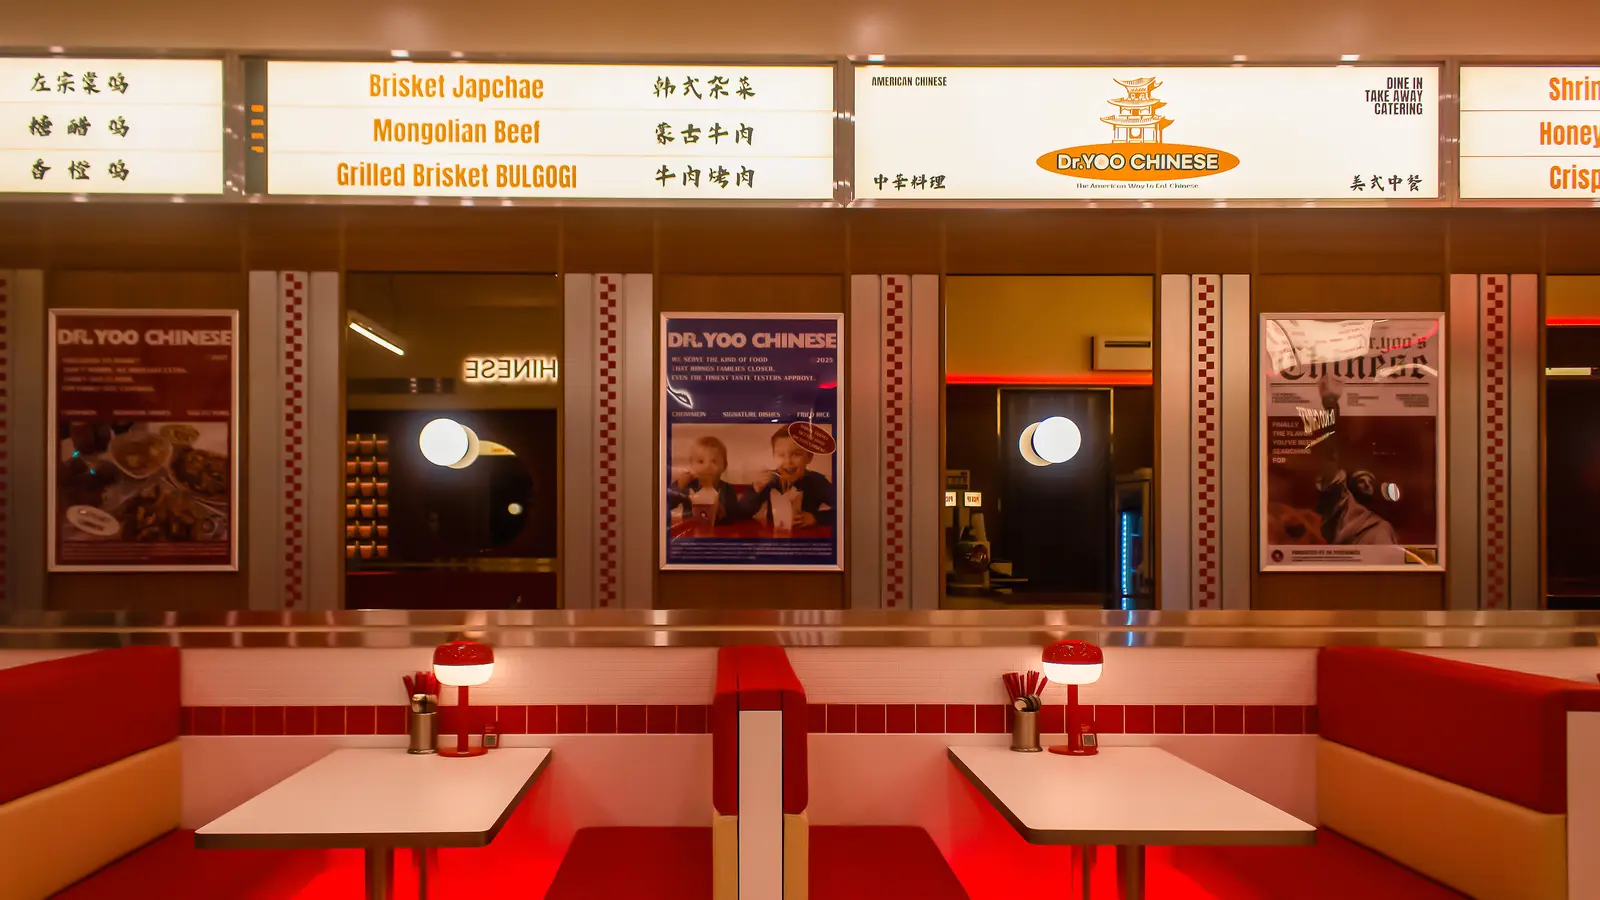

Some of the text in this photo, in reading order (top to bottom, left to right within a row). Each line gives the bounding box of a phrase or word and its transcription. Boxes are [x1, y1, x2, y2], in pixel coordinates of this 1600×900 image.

[370, 73, 543, 102] Brisket Japchae
[653, 76, 755, 100] 韩式杂菜
[872, 77, 946, 86] AMERICAN CHINESE
[1387, 77, 1422, 89] DINE IN
[1362, 89, 1423, 102] TAKE AWAY
[1374, 102, 1423, 115] CATERING
[374, 119, 540, 145] Mongolian Beef
[656, 122, 753, 145] 蒙古牛肉
[1057, 153, 1219, 170] Dr.YOO CHINESE
[337, 162, 576, 188] Grilled Brisket BULGOGI
[655, 165, 754, 189] 牛肉烤肉
[874, 173, 945, 191] 中華料理
[1350, 175, 1422, 191] 美式中餐
[58, 329, 232, 346] DR.YOO CHINESE
[668, 332, 837, 349] DR.YOO CHINESE
[1369, 333, 1427, 352] r.yoo's
[721, 356, 736, 364] KIND
[739, 356, 747, 364] OF
[750, 356, 768, 364] FOOD
[816, 356, 833, 364] 2025
